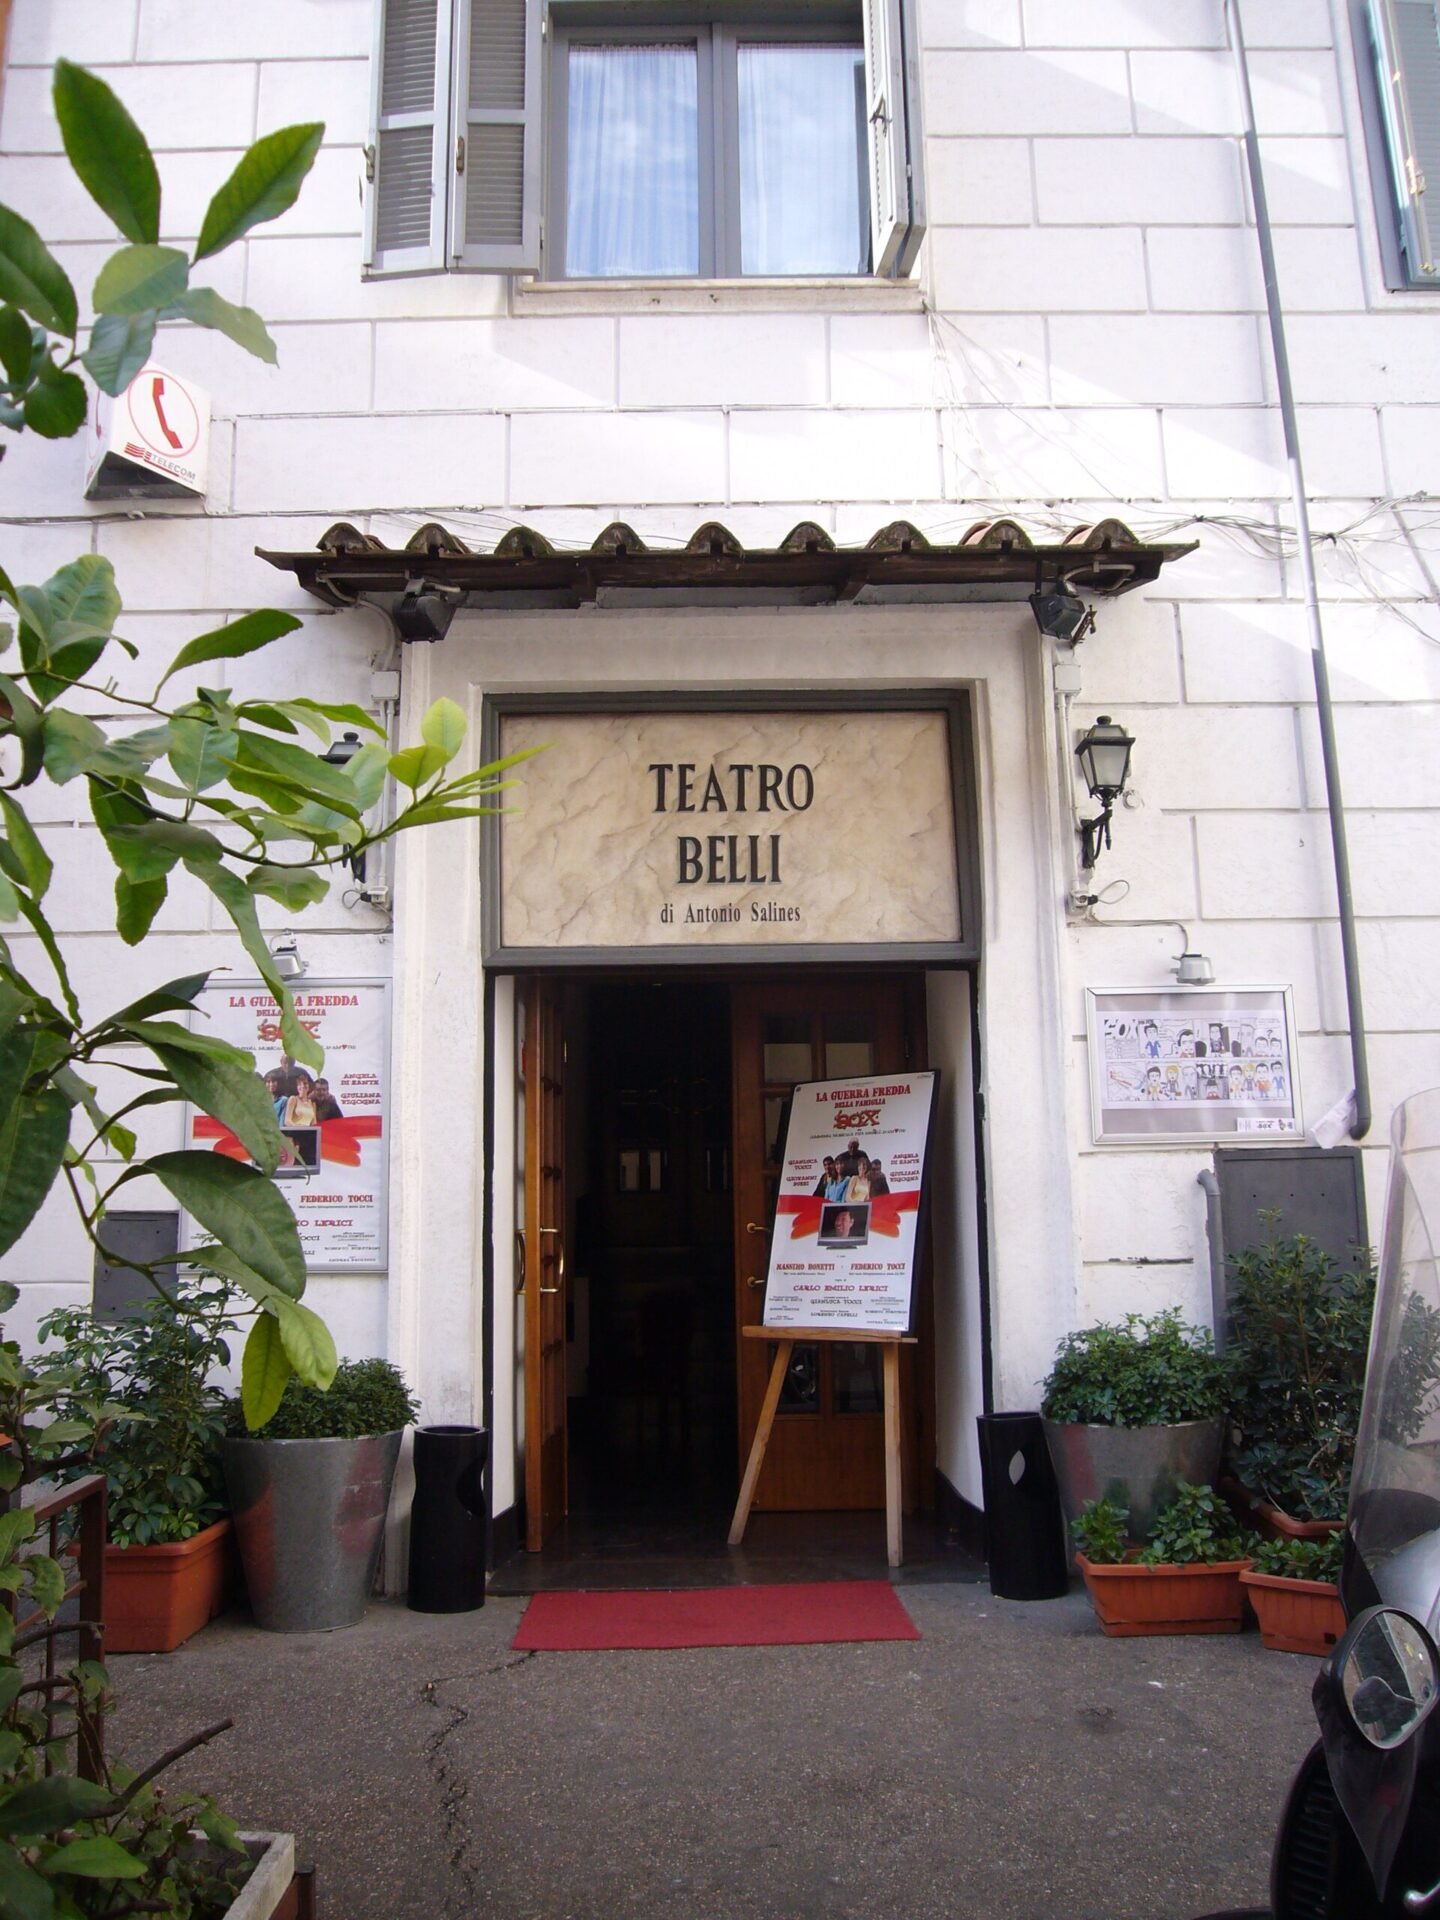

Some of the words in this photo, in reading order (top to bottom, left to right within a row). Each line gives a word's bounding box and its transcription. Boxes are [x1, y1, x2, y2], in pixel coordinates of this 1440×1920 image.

[152, 454, 196, 480] TELECOM
[648, 763, 814, 812] TEATRO
[677, 834, 781, 884] BELLI
[661, 903, 674, 923] di
[684, 903, 741, 923] Antonio
[751, 902, 800, 922] Salines
[229, 996, 246, 1007] LA
[307, 995, 359, 1006] FREDDA
[815, 1092, 828, 1102] LA
[831, 1088, 869, 1101] GUERRA
[872, 1084, 911, 1097] FREDDA
[855, 1098, 886, 1107] FAMIGLIA
[300, 1195, 344, 1203] FEDERICO
[347, 1194, 373, 1203] TOCCI
[315, 1219, 354, 1227] LERICI
[887, 1262, 906, 1270] TOCCI
[793, 1284, 821, 1292] CARLO
[824, 1284, 855, 1292] EMILIO
